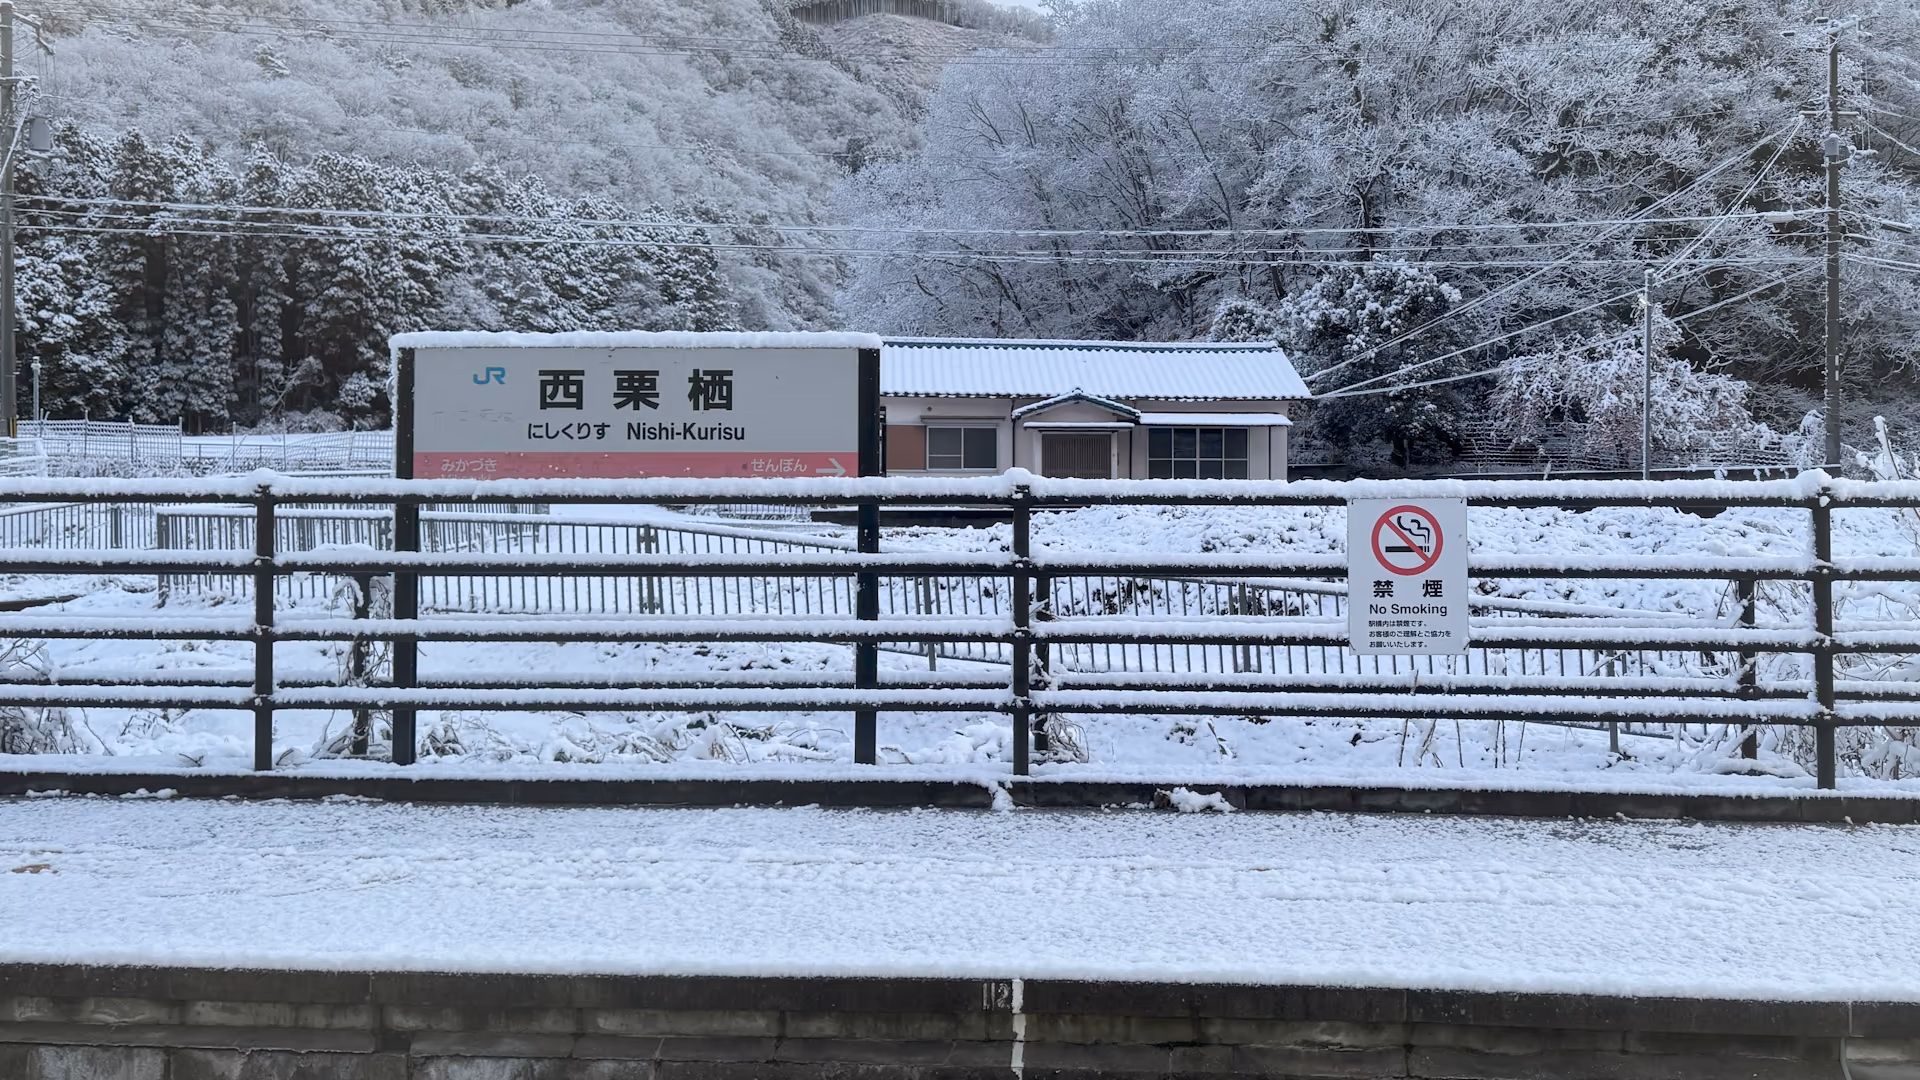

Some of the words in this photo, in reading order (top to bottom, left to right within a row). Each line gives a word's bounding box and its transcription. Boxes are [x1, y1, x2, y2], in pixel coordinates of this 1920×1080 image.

[473, 367, 506, 385] JR
[538, 369, 734, 411] 西栗栖
[528, 422, 611, 440] にしくりす
[627, 422, 745, 441] Nishi-Kurisu
[441, 457, 498, 473] みかづき
[1369, 604, 1387, 615] No
[1391, 604, 1448, 617] Smoking
[1368, 630, 1452, 638] お客様のご理解とご協力を
